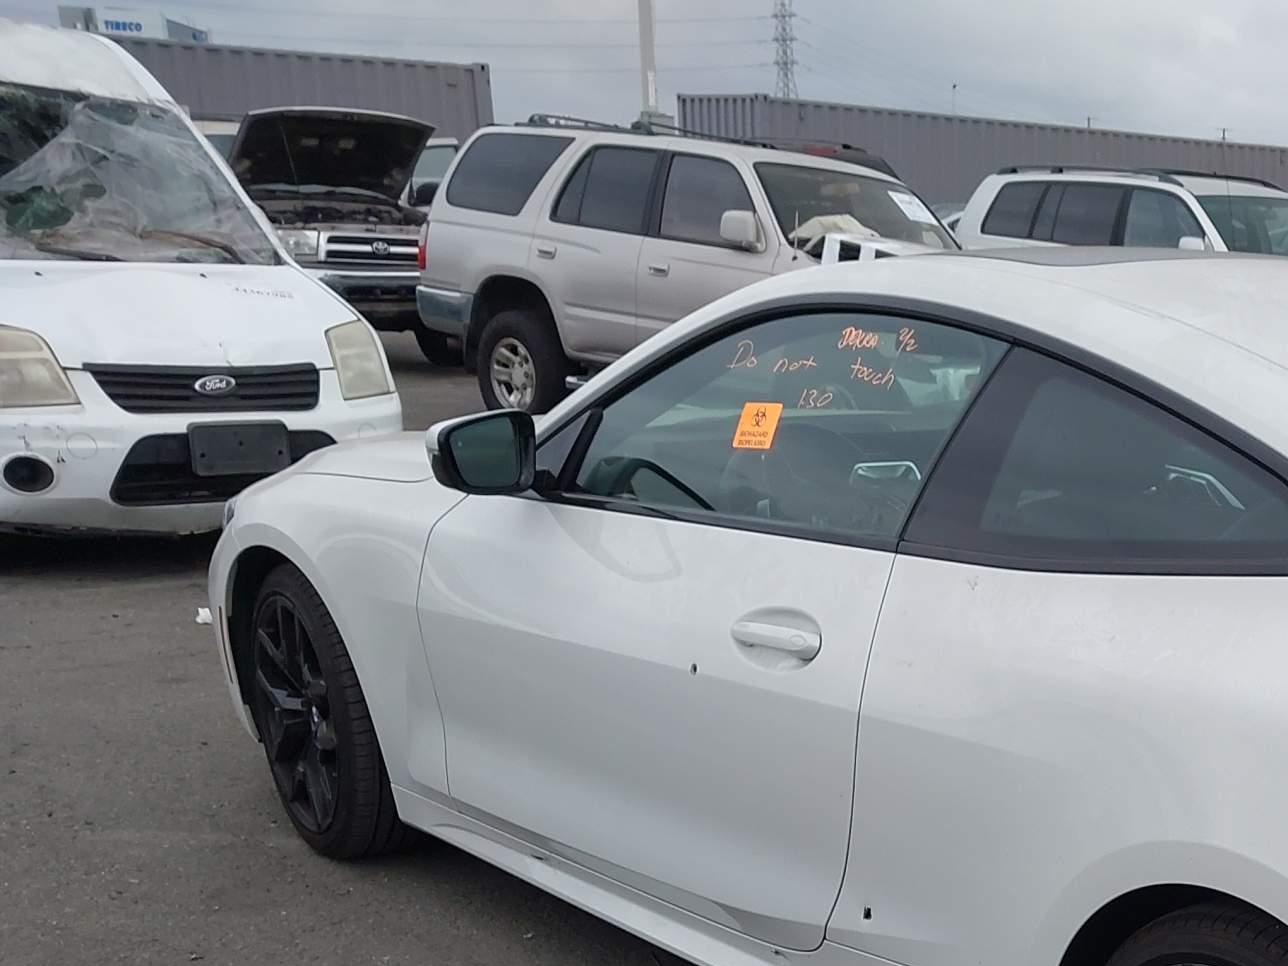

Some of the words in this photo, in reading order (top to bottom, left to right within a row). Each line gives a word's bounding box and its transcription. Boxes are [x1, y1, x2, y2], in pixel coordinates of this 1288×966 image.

[727, 340, 758, 369] Do
[773, 355, 817, 373] not
[850, 356, 895, 391] touch
